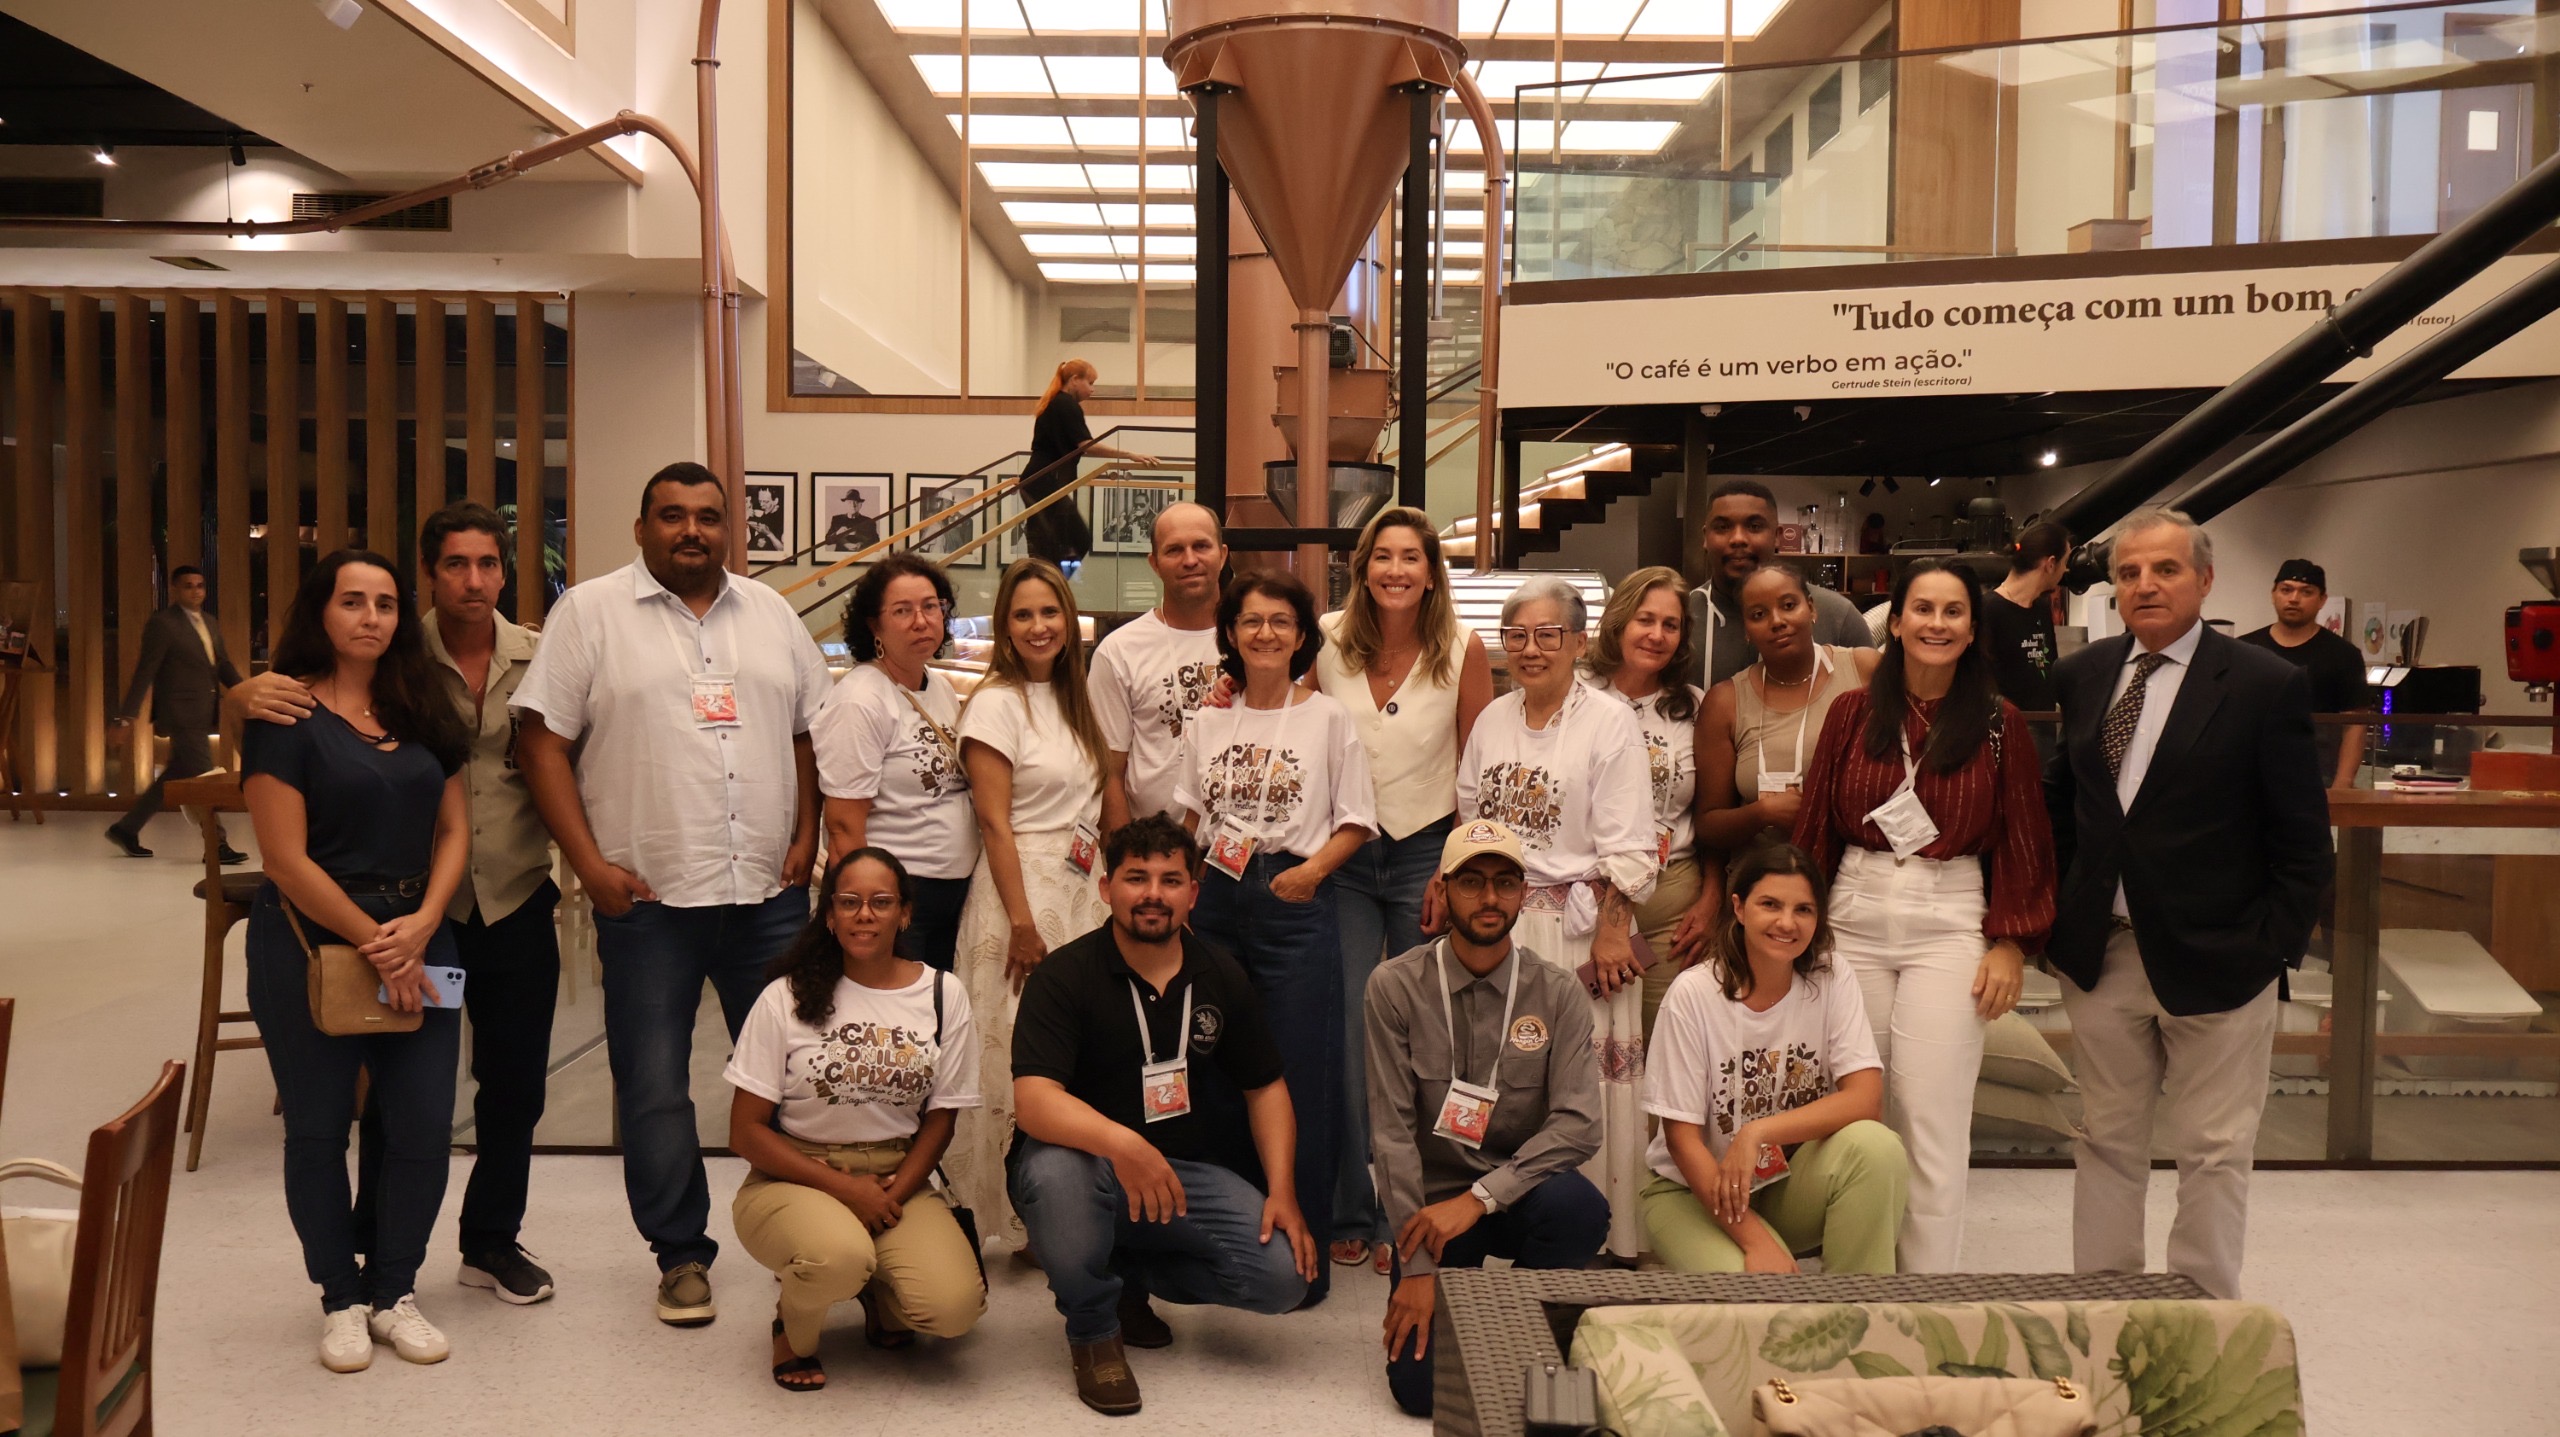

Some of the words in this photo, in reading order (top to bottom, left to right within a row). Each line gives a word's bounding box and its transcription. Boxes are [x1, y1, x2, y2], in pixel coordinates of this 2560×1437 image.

[1833, 300, 1934, 331] "Tudo
[1943, 298, 2075, 331] começa
[2085, 294, 2162, 321] com
[2173, 290, 2235, 317] um
[2245, 282, 2333, 312] bom
[2417, 314, 2456, 327] (ator)
[1606, 362, 1633, 380] "O
[1641, 358, 1690, 379] café
[1698, 358, 1711, 377] é
[1720, 360, 1759, 376] um
[1767, 354, 1837, 374] verbo
[1846, 355, 1885, 371] em
[1895, 349, 1972, 374] ação."
[1832, 378, 1880, 390] Gertrude
[1882, 377, 1911, 388] Stein
[1914, 376, 1972, 389] (escritora)
[839, 1022, 906, 1050] CAFÉ
[828, 1043, 924, 1072] CONILON
